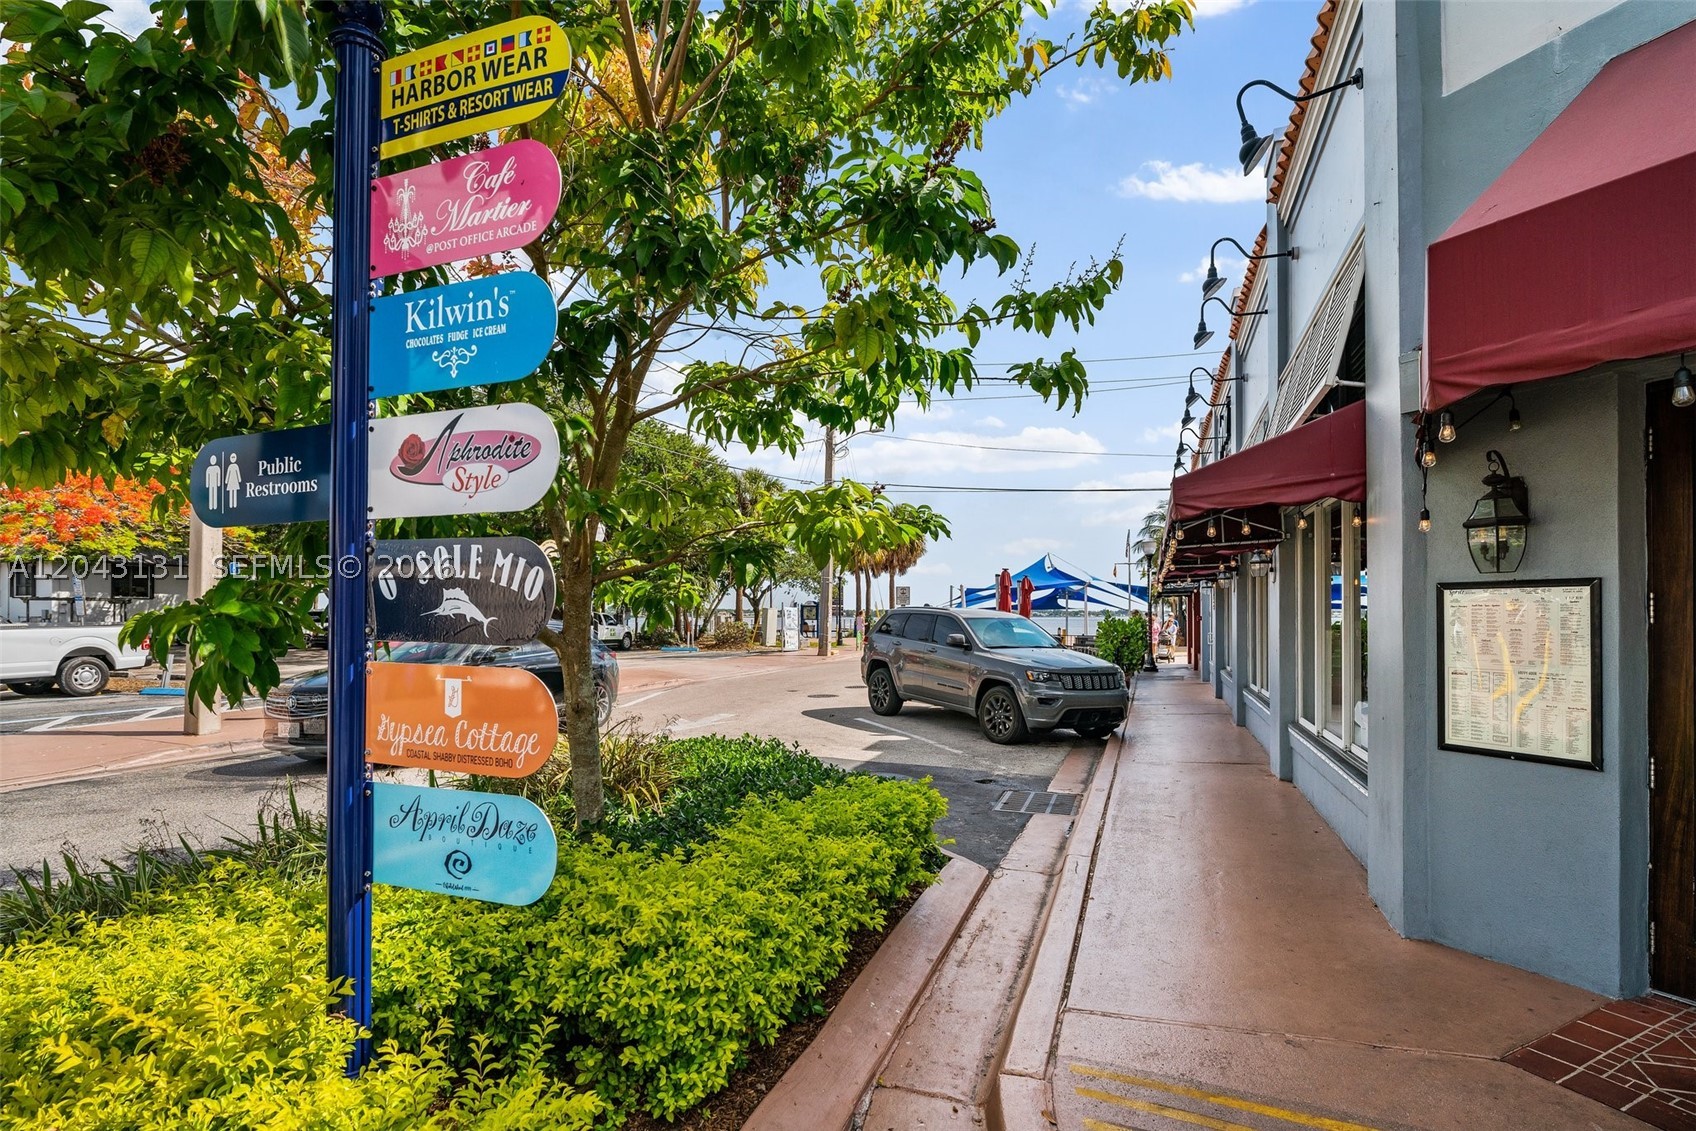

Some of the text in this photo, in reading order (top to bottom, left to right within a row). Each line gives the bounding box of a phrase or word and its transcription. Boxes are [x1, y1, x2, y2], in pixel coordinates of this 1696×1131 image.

[391, 47, 548, 110] HARBOR WEAR
[393, 78, 553, 135] T-SHIRTS & RESORT WEAR
[426, 220, 537, 254] @POST OFFICE ARCADE
[430, 194, 533, 236] Martier
[404, 286, 509, 334] Kilwin's
[405, 323, 507, 350] CHOCOLATES FUDGE ICE CREAM
[257, 456, 302, 477] Public
[397, 412, 532, 476] Aphrodite
[245, 478, 318, 499] Restrooms
[451, 465, 502, 500] Style
[415, 544, 483, 585] SOLE
[490, 548, 545, 601] MIO
[376, 713, 541, 769] Gypsea Cottage
[406, 748, 513, 768] COASTAL SHABBY DISTRESSED BOHO
[389, 794, 538, 845] April Daze
